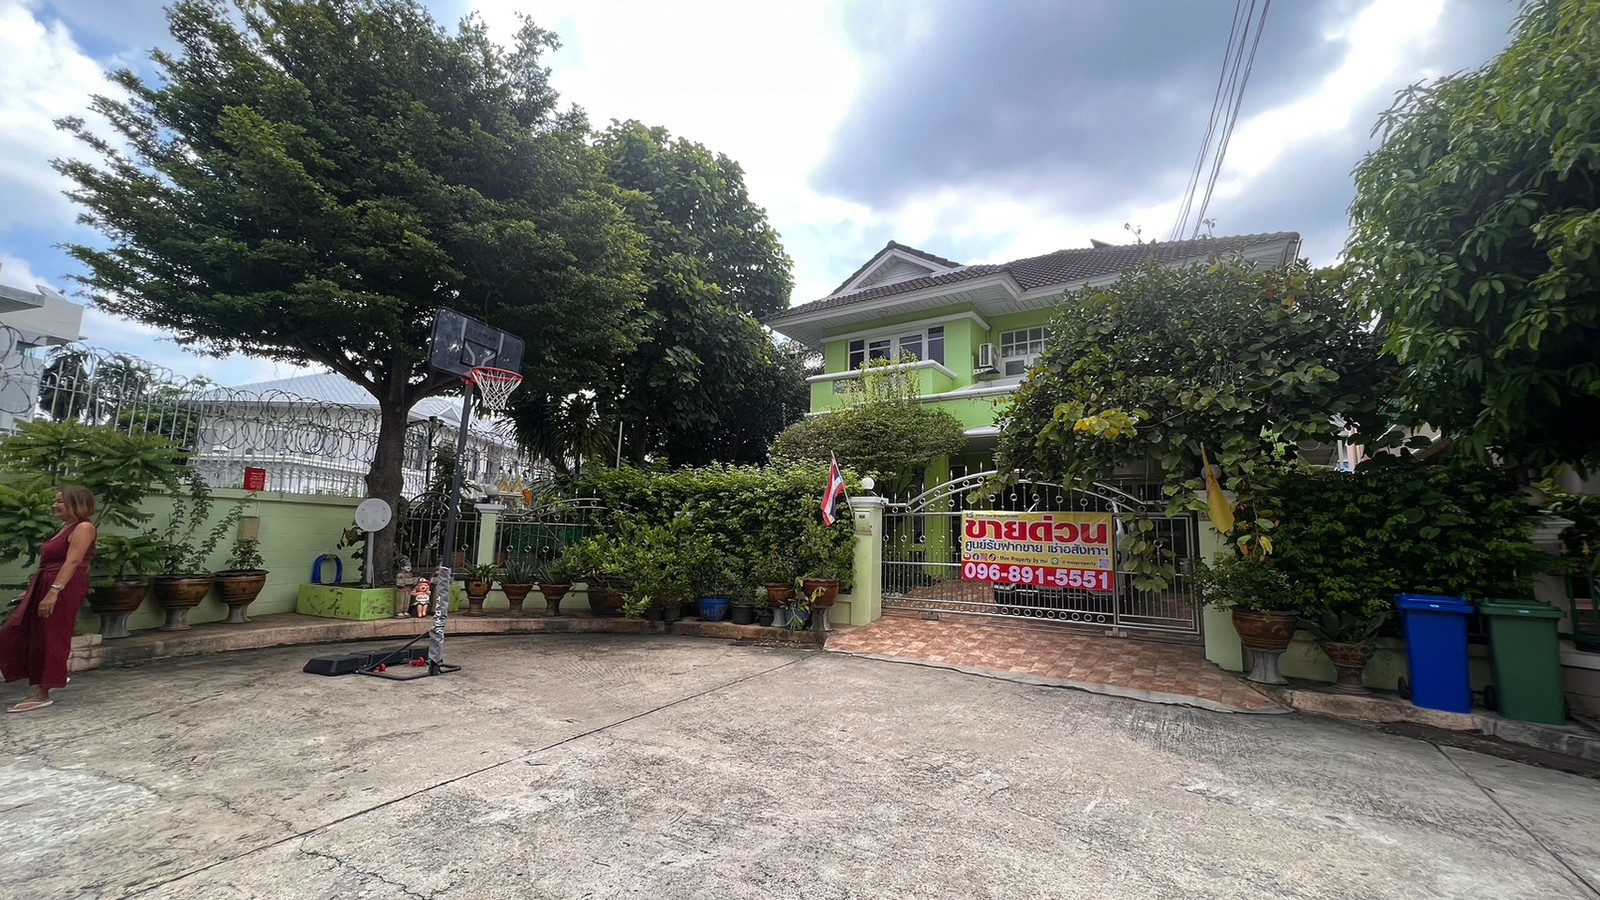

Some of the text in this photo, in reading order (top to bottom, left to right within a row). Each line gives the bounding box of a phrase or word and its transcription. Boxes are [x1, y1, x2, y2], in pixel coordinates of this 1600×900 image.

[965, 515, 1108, 544] ขายด่วน
[965, 539, 1043, 553] ศูนย์รับฝากขาย
[964, 562, 1108, 589] 096-891-5551
